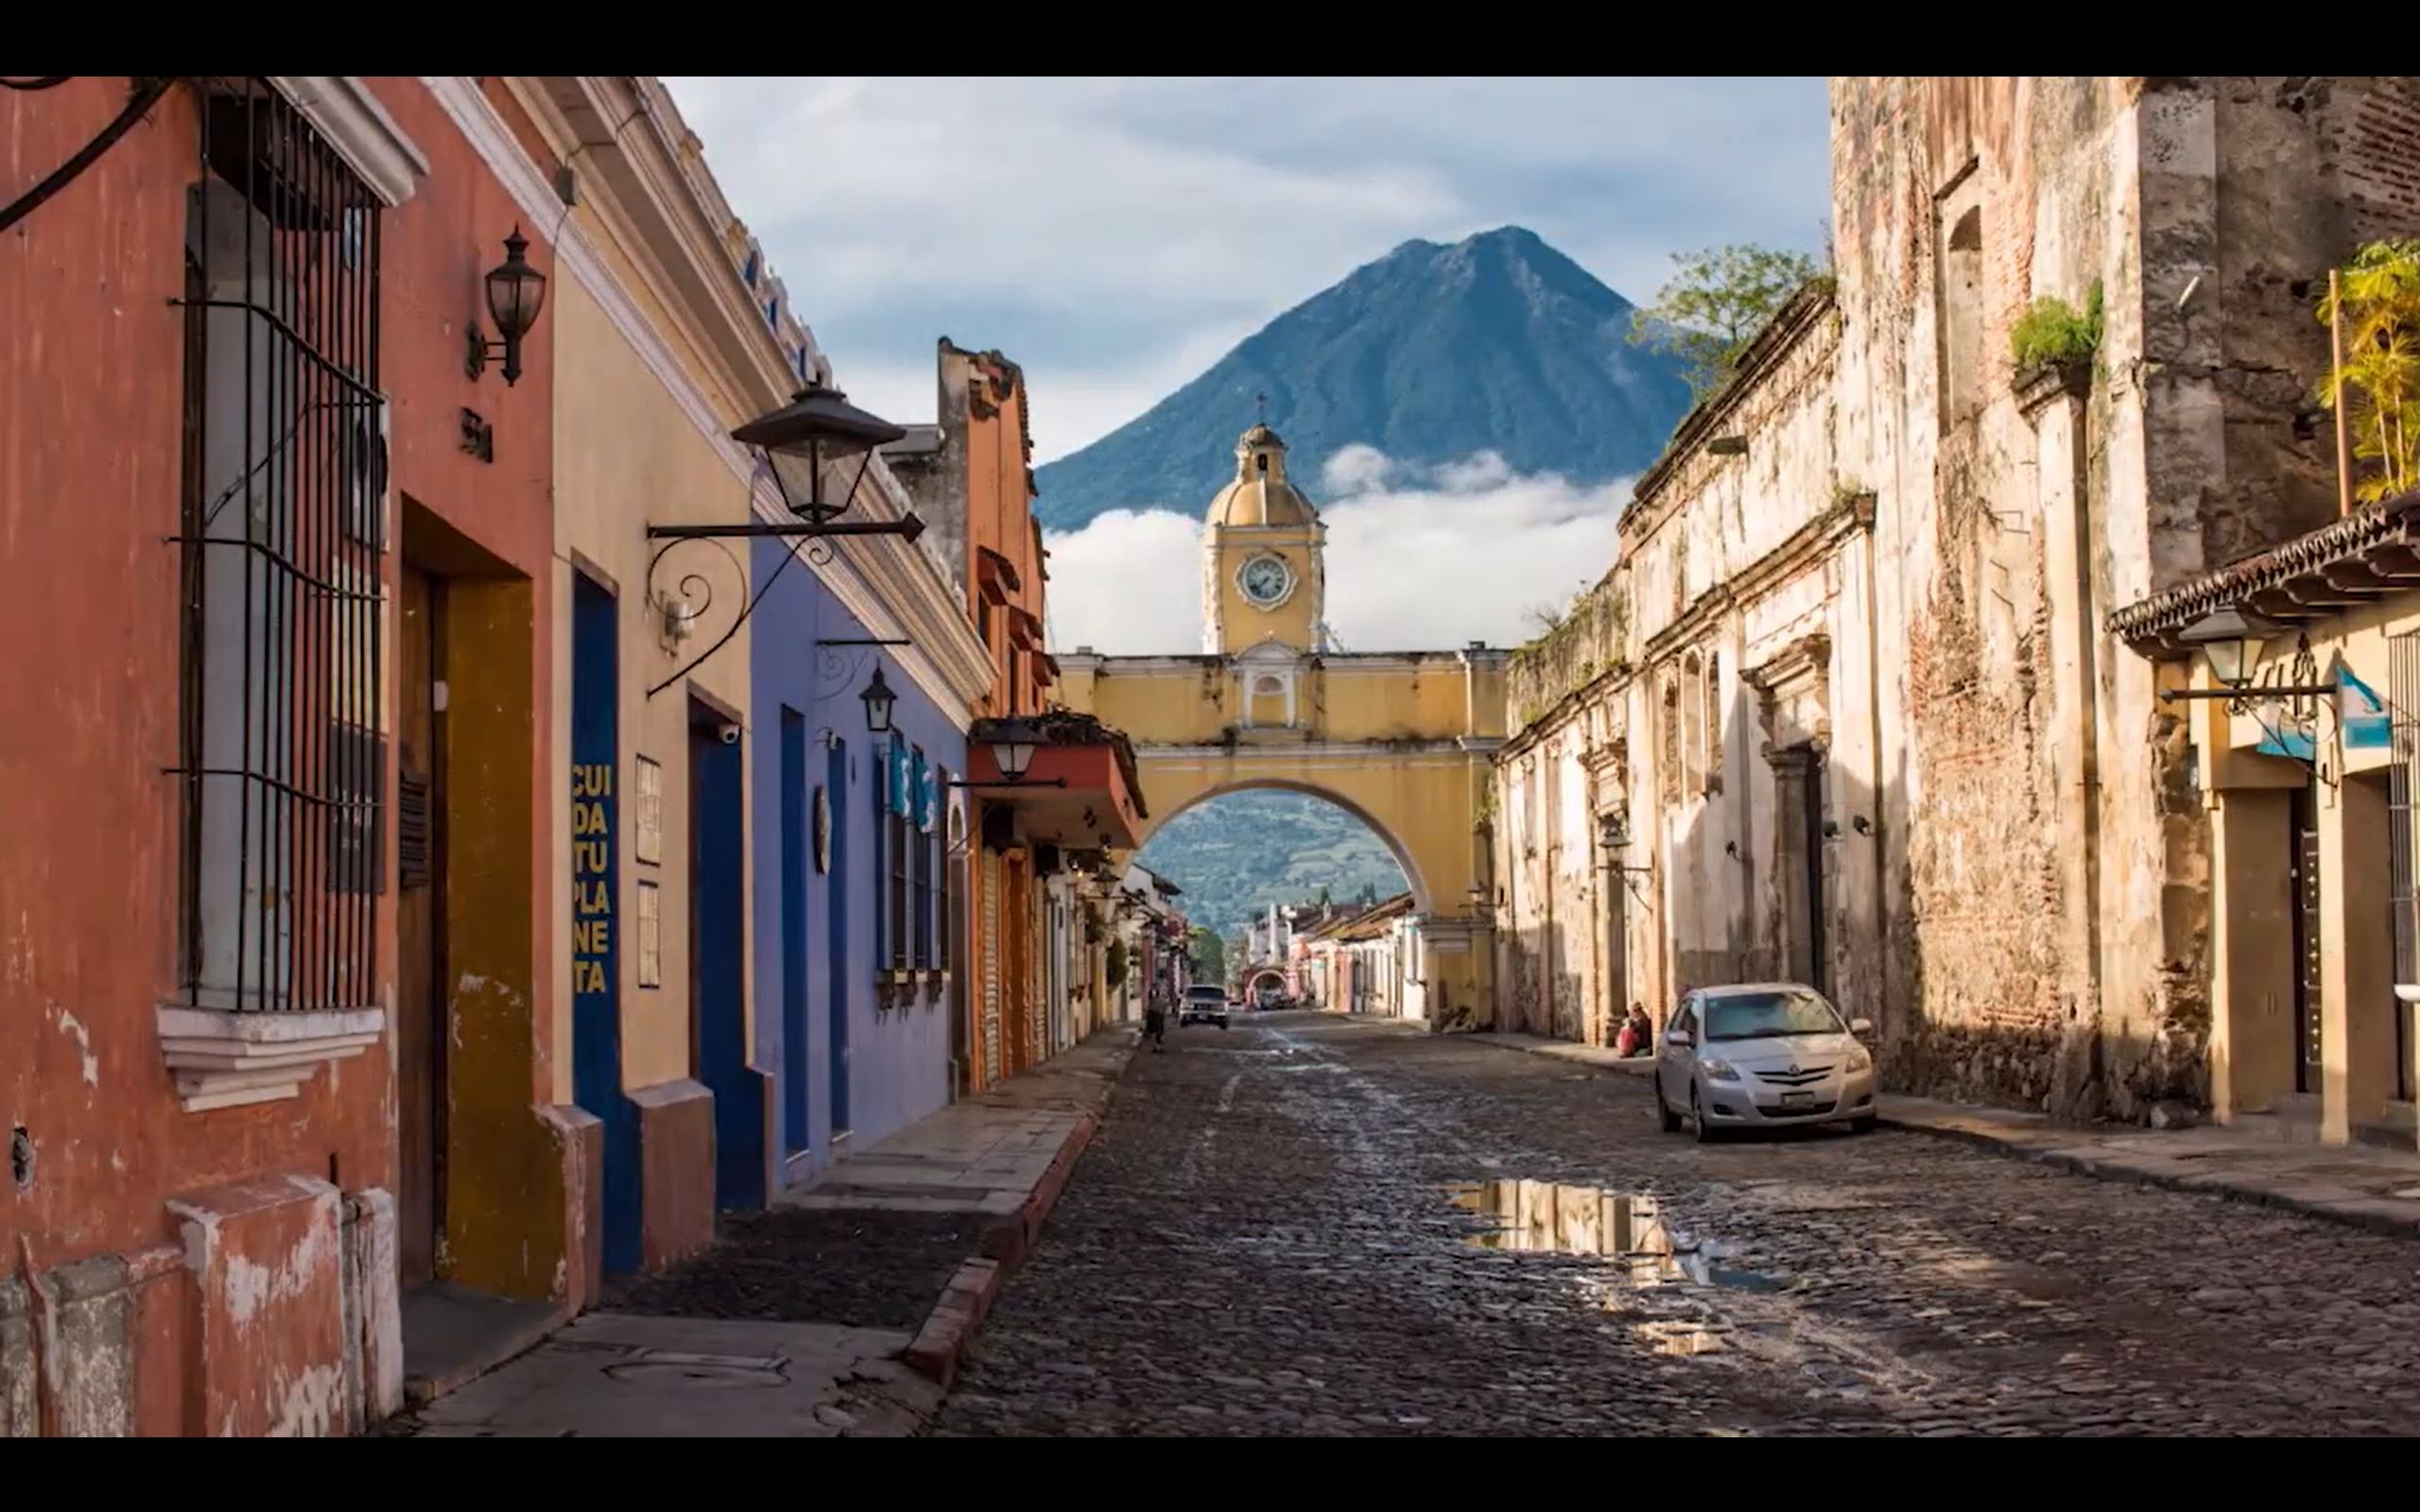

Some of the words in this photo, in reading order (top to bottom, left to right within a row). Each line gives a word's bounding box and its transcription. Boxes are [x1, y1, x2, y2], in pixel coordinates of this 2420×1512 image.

[573, 764, 611, 796] CUI
[573, 802, 607, 834] DA
[574, 841, 607, 873] TU
[574, 920, 608, 954] NE
[574, 960, 606, 992] TA
